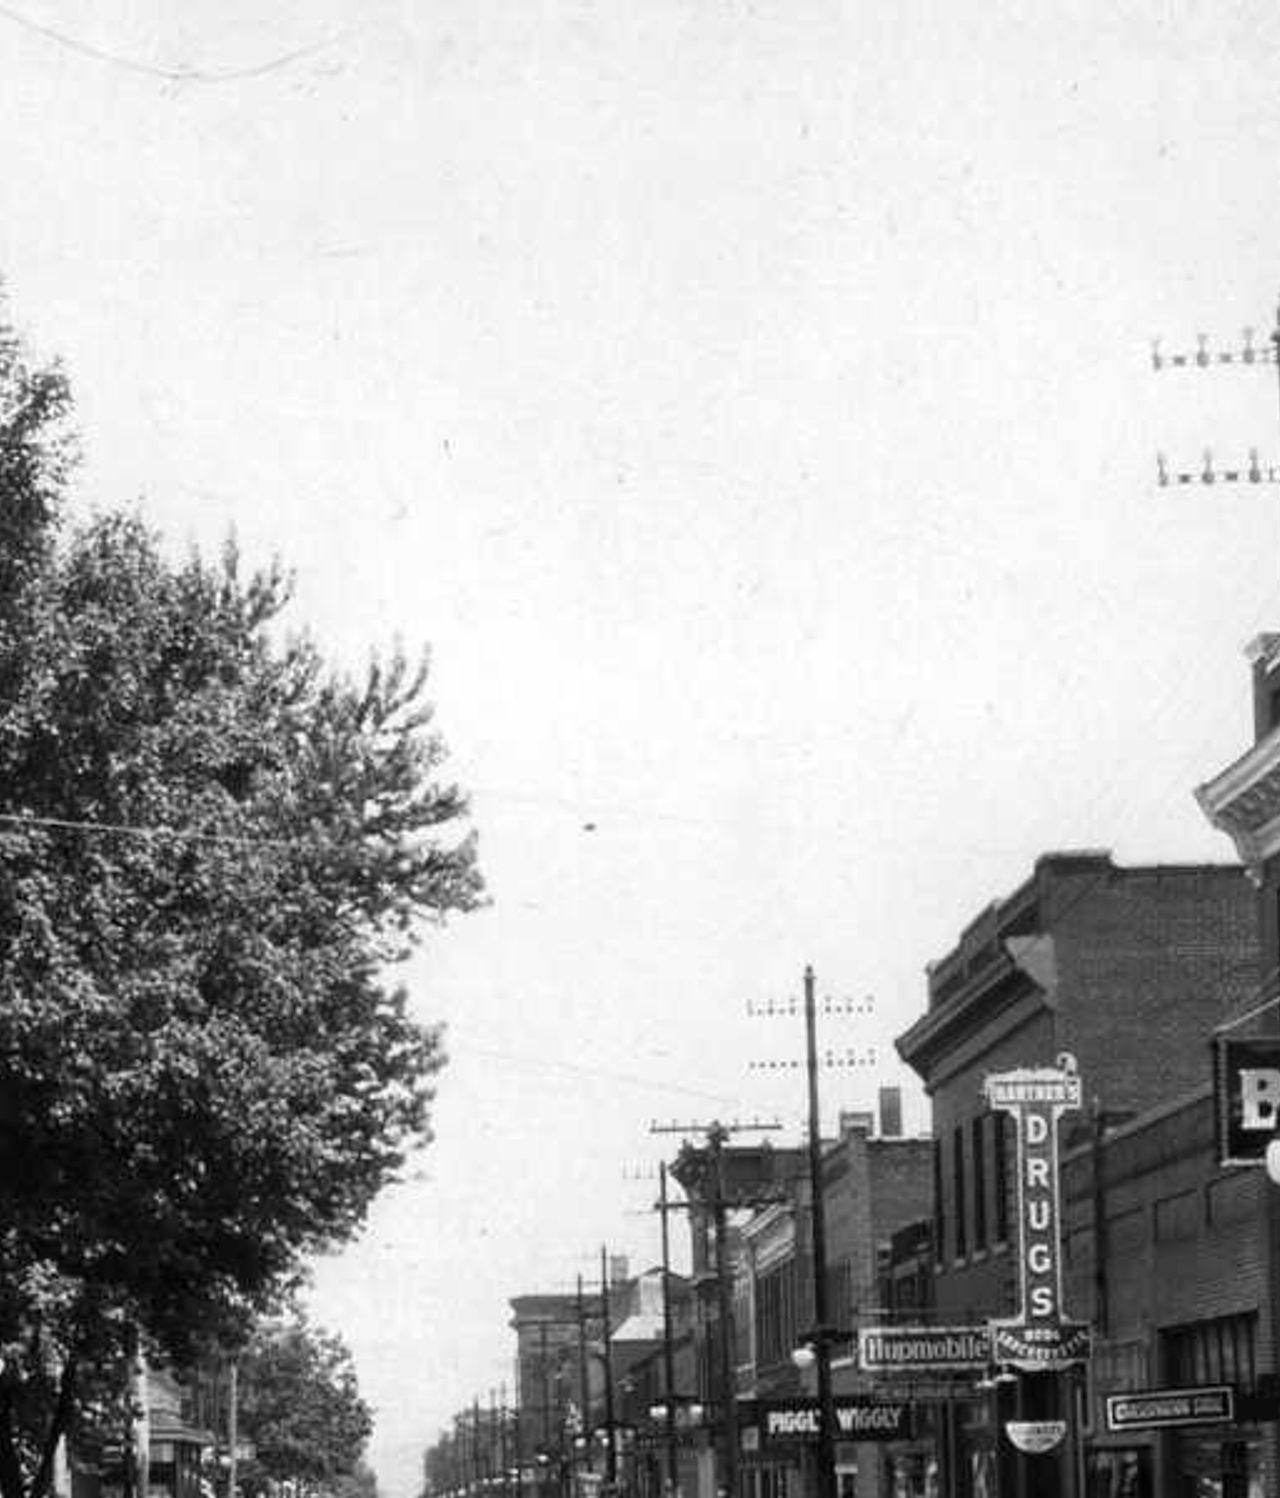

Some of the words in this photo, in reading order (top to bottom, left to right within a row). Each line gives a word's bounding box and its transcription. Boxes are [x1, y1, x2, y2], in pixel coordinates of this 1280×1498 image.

[1026, 1115, 1054, 1317] DRUGS
[768, 1408, 821, 1433] PIGGL
[836, 1406, 902, 1431] WIGGLY
